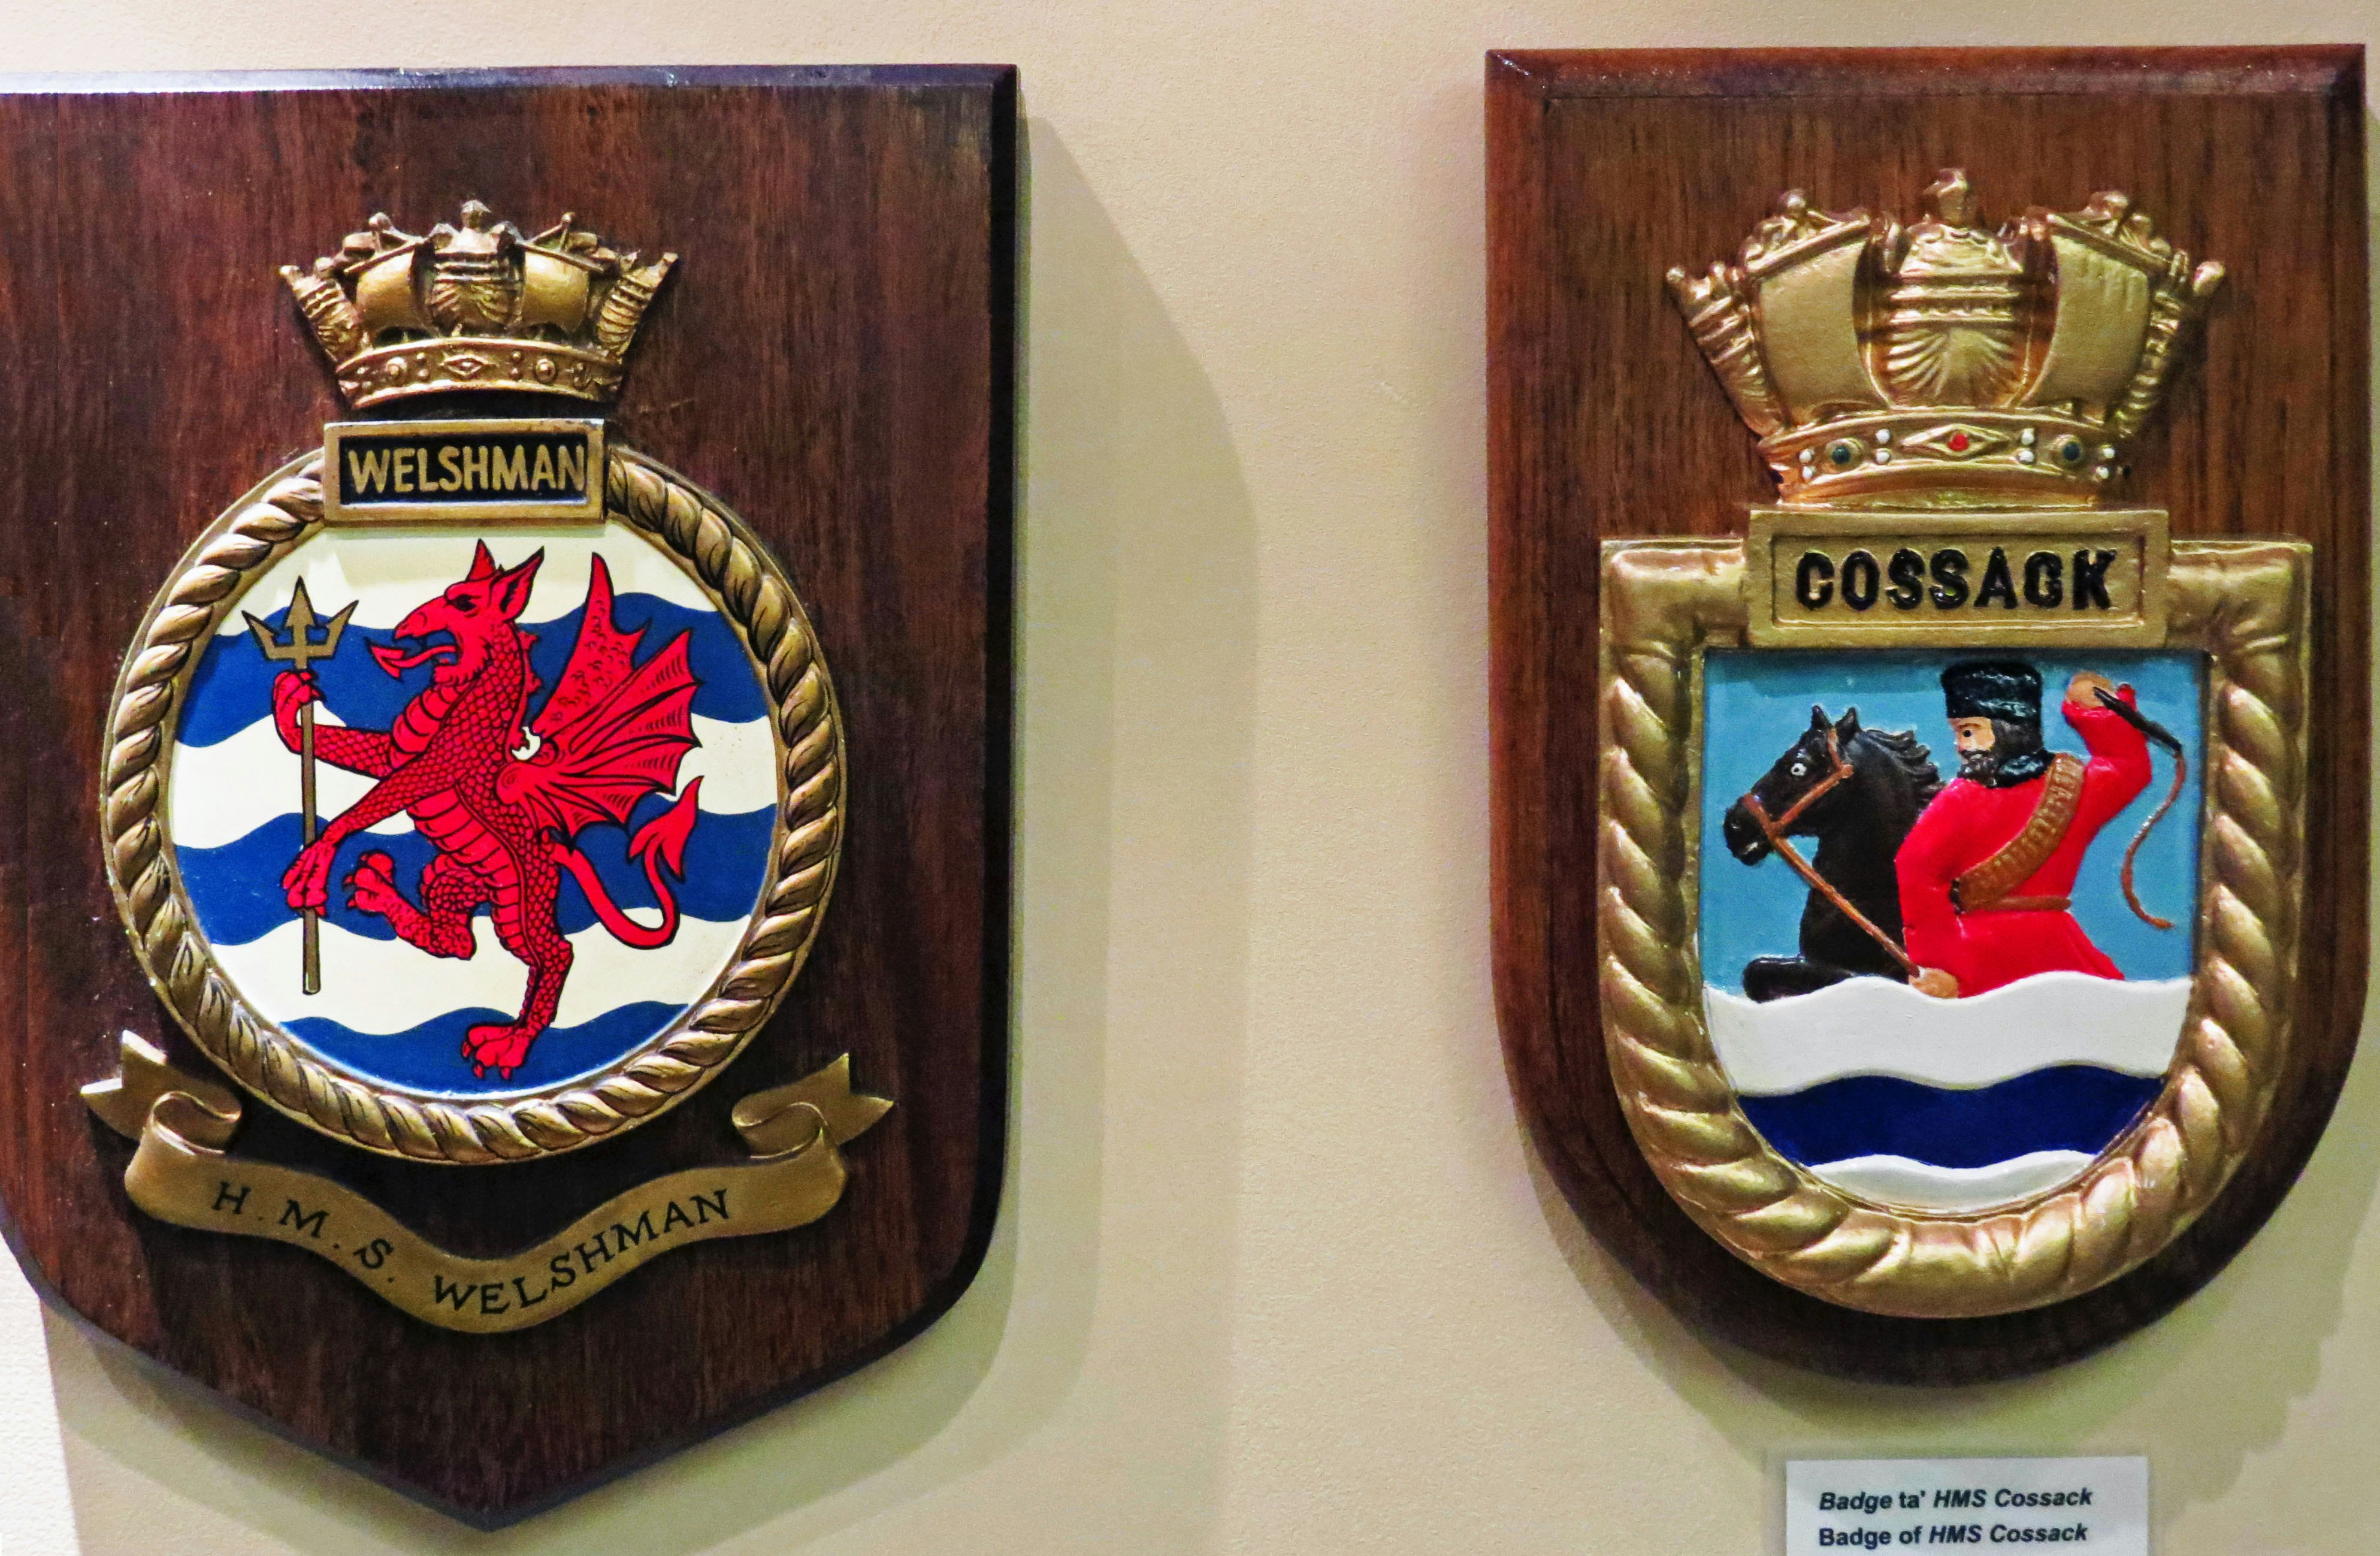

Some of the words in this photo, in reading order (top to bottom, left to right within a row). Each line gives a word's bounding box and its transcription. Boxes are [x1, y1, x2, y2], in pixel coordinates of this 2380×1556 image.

[347, 444, 585, 494] WELSHMAN
[1796, 546, 2118, 611] COSSACK
[211, 1180, 395, 1283] H.M.S.
[434, 1188, 730, 1314] WELSHMAN
[1819, 1491, 1893, 1514] Badge
[1898, 1490, 1927, 1509] ta'
[1933, 1489, 1987, 1509] HMS
[1994, 1488, 2093, 1508] Cossack
[1819, 1527, 1892, 1549] Badge
[1898, 1525, 1922, 1545] of
[1928, 1524, 1982, 1544] HMS
[1989, 1523, 2088, 1543] Cossack
